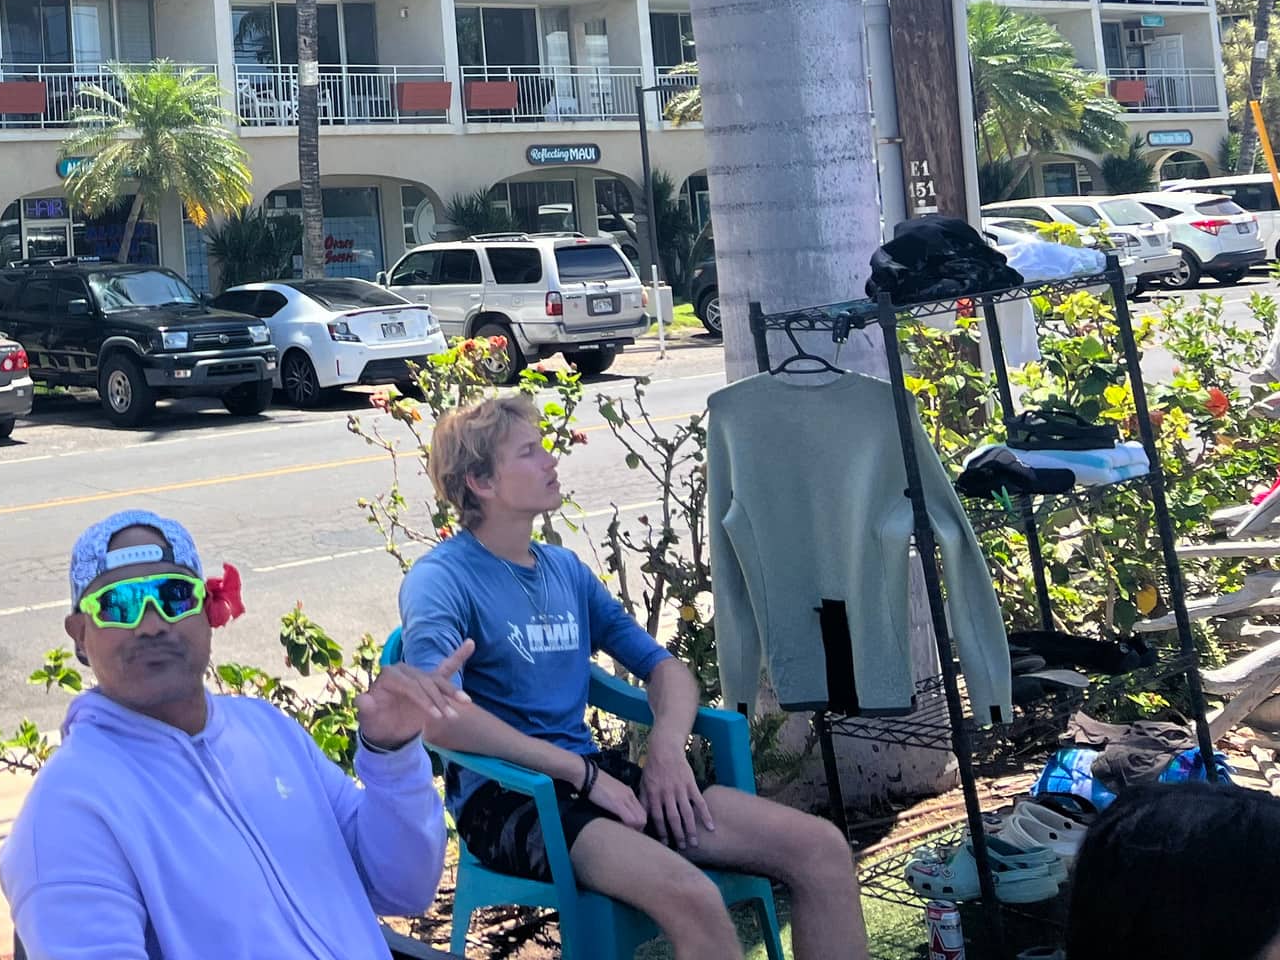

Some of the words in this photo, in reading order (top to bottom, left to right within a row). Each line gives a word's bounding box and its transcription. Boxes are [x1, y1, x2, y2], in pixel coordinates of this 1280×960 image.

[531, 148, 569, 162] Reflecting
[569, 147, 596, 160] MAUI
[910, 160, 930, 176] E1
[909, 180, 936, 197] 151
[26, 199, 64, 216] HAIR
